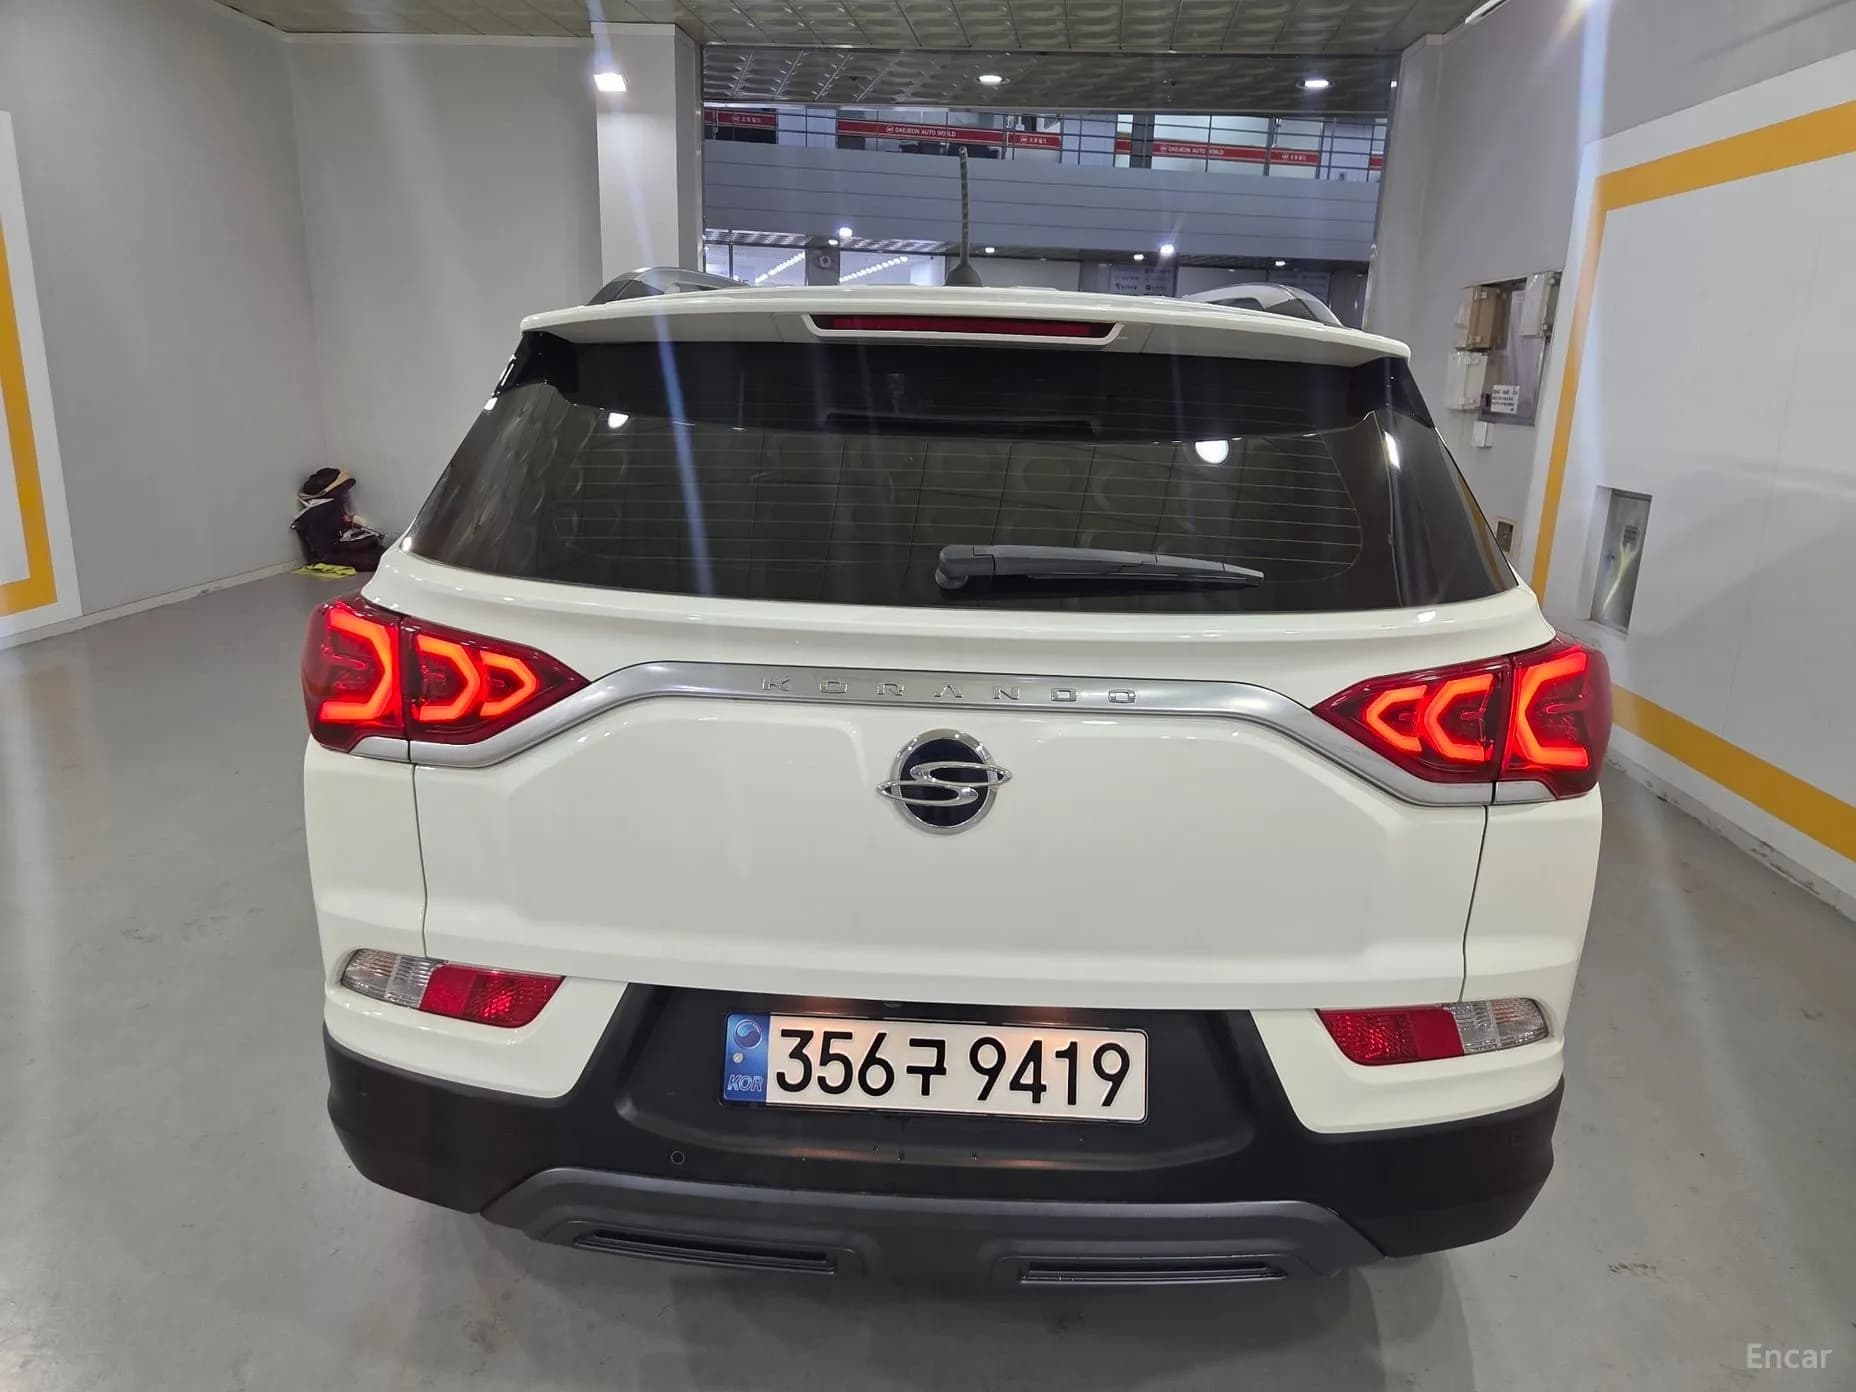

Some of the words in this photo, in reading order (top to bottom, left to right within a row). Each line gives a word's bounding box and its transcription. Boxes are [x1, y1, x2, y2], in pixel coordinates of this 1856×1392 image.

[895, 127, 920, 135] DAEJEON
[762, 675, 1136, 704] KORANDO
[776, 1028, 947, 1097] 356구
[969, 1037, 1131, 1107] 9419
[727, 1074, 763, 1092] KOR
